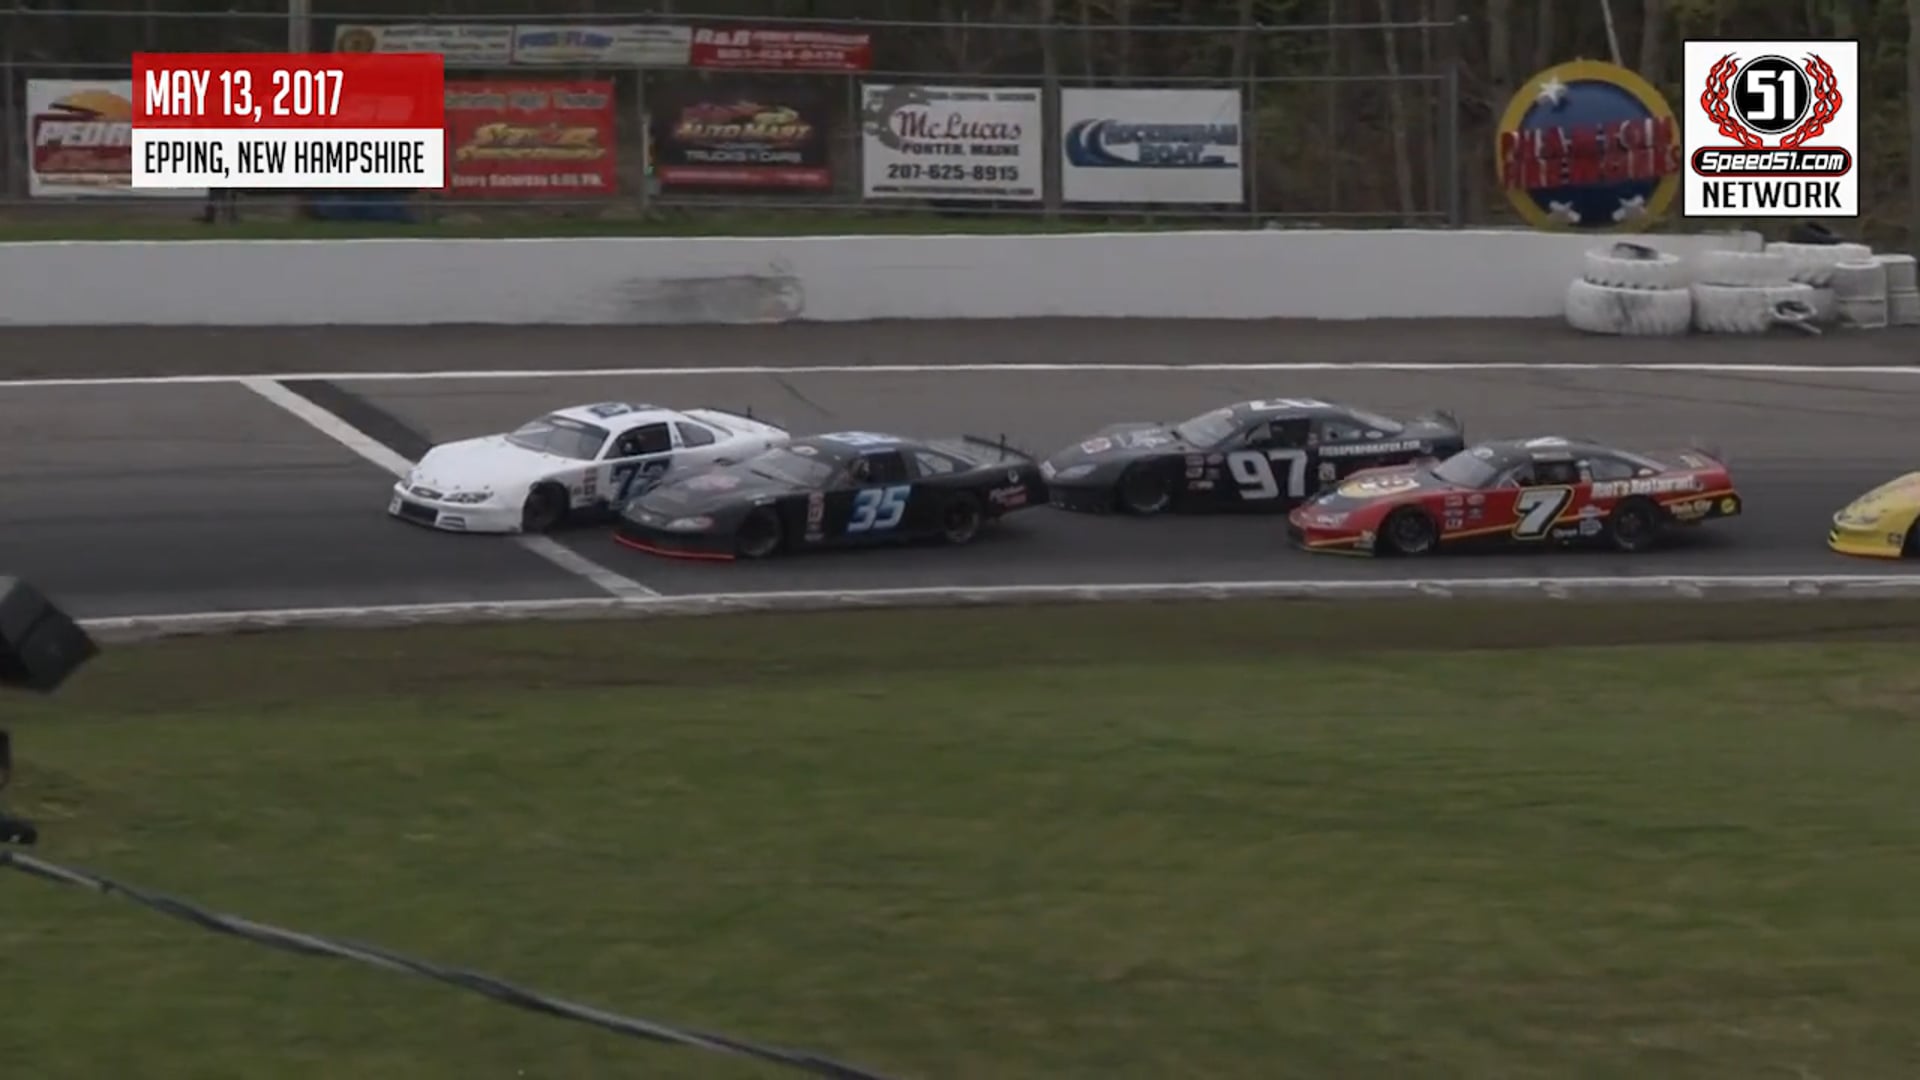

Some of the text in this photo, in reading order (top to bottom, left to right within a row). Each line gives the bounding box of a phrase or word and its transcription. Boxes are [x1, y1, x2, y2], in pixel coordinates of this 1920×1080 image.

[896, 111, 1022, 140] McLucas
[887, 164, 1019, 182] 207-625-8915
[1227, 447, 1307, 500] 97
[847, 484, 912, 533] 35
[1513, 486, 1572, 538] 7
